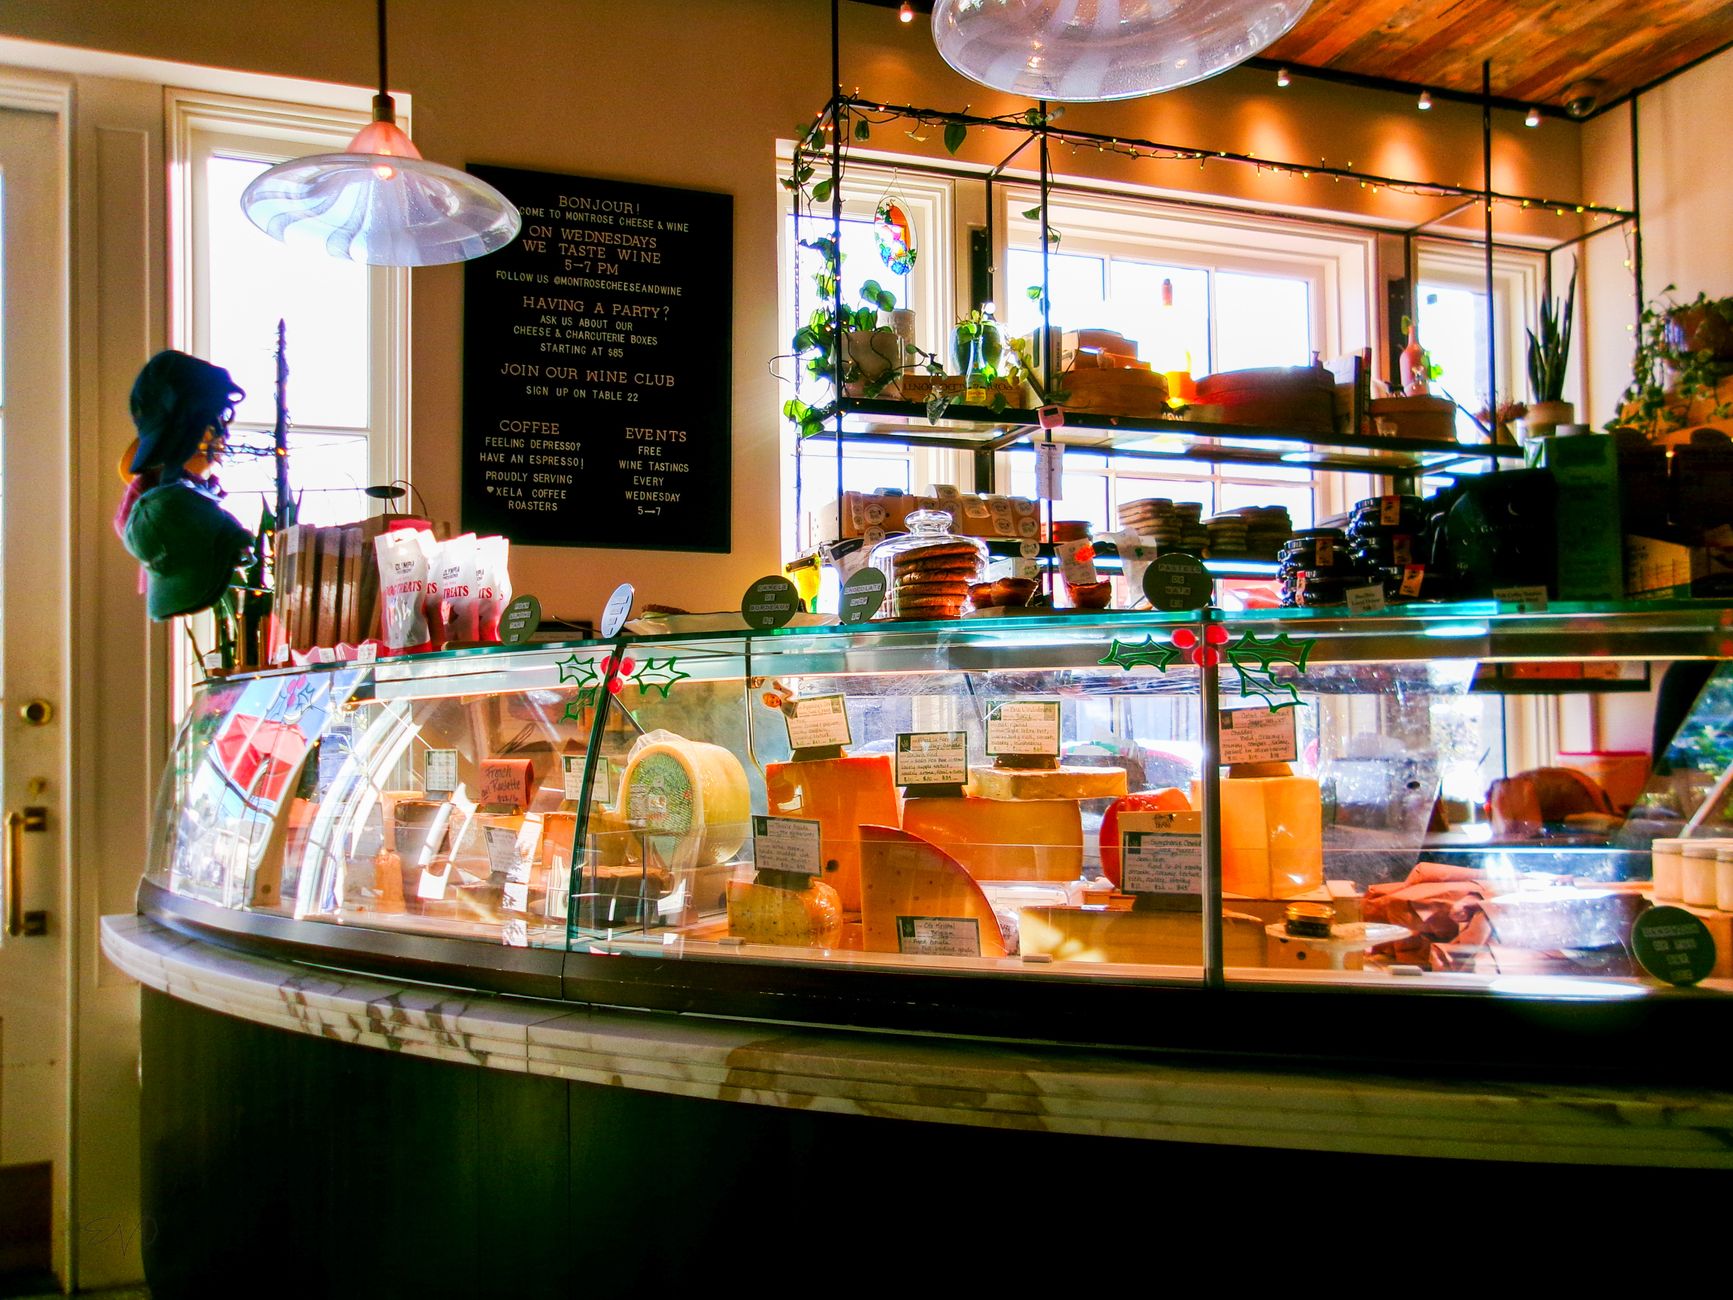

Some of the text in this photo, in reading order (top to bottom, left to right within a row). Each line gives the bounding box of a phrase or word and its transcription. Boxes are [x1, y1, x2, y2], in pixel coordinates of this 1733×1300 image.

[559, 196, 640, 214] BONJOUR!
[519, 206, 689, 232] COME TO MONTROSE CHEESE & WINE
[529, 226, 657, 249] ON WEDNESDAYS
[523, 240, 661, 264] WE TASTE WINE
[598, 263, 619, 275] PM
[496, 271, 682, 296] FOLLOW US @MONTROSECHEESEANDWINE
[523, 296, 670, 321] HAVING A PARTY?
[540, 316, 633, 331] ASK US ABOUT OUR
[514, 326, 658, 345] CHEESE & CHARCUTERIE BOXES
[540, 343, 623, 358] STARTING AT $85
[501, 363, 675, 387] JOIN OUR WINE CLUB
[526, 386, 638, 402] SIGN UP ON TABLE 22
[499, 420, 560, 435] COFFEE
[626, 428, 687, 442] EVENTS
[485, 437, 581, 451] FEELING DEPRESSO?
[638, 446, 662, 456] FREE
[480, 452, 584, 470] HAVE AN ESPRESSO!
[619, 460, 689, 473] WINE TASTINGS
[486, 471, 573, 484] PROUDLY SERVING
[634, 476, 664, 486] EVERY
[496, 487, 566, 500] XELA COFFEE
[625, 491, 681, 502] WEDNESDAY
[508, 501, 558, 511] ROASTERS
[443, 585, 469, 599] TREATS
